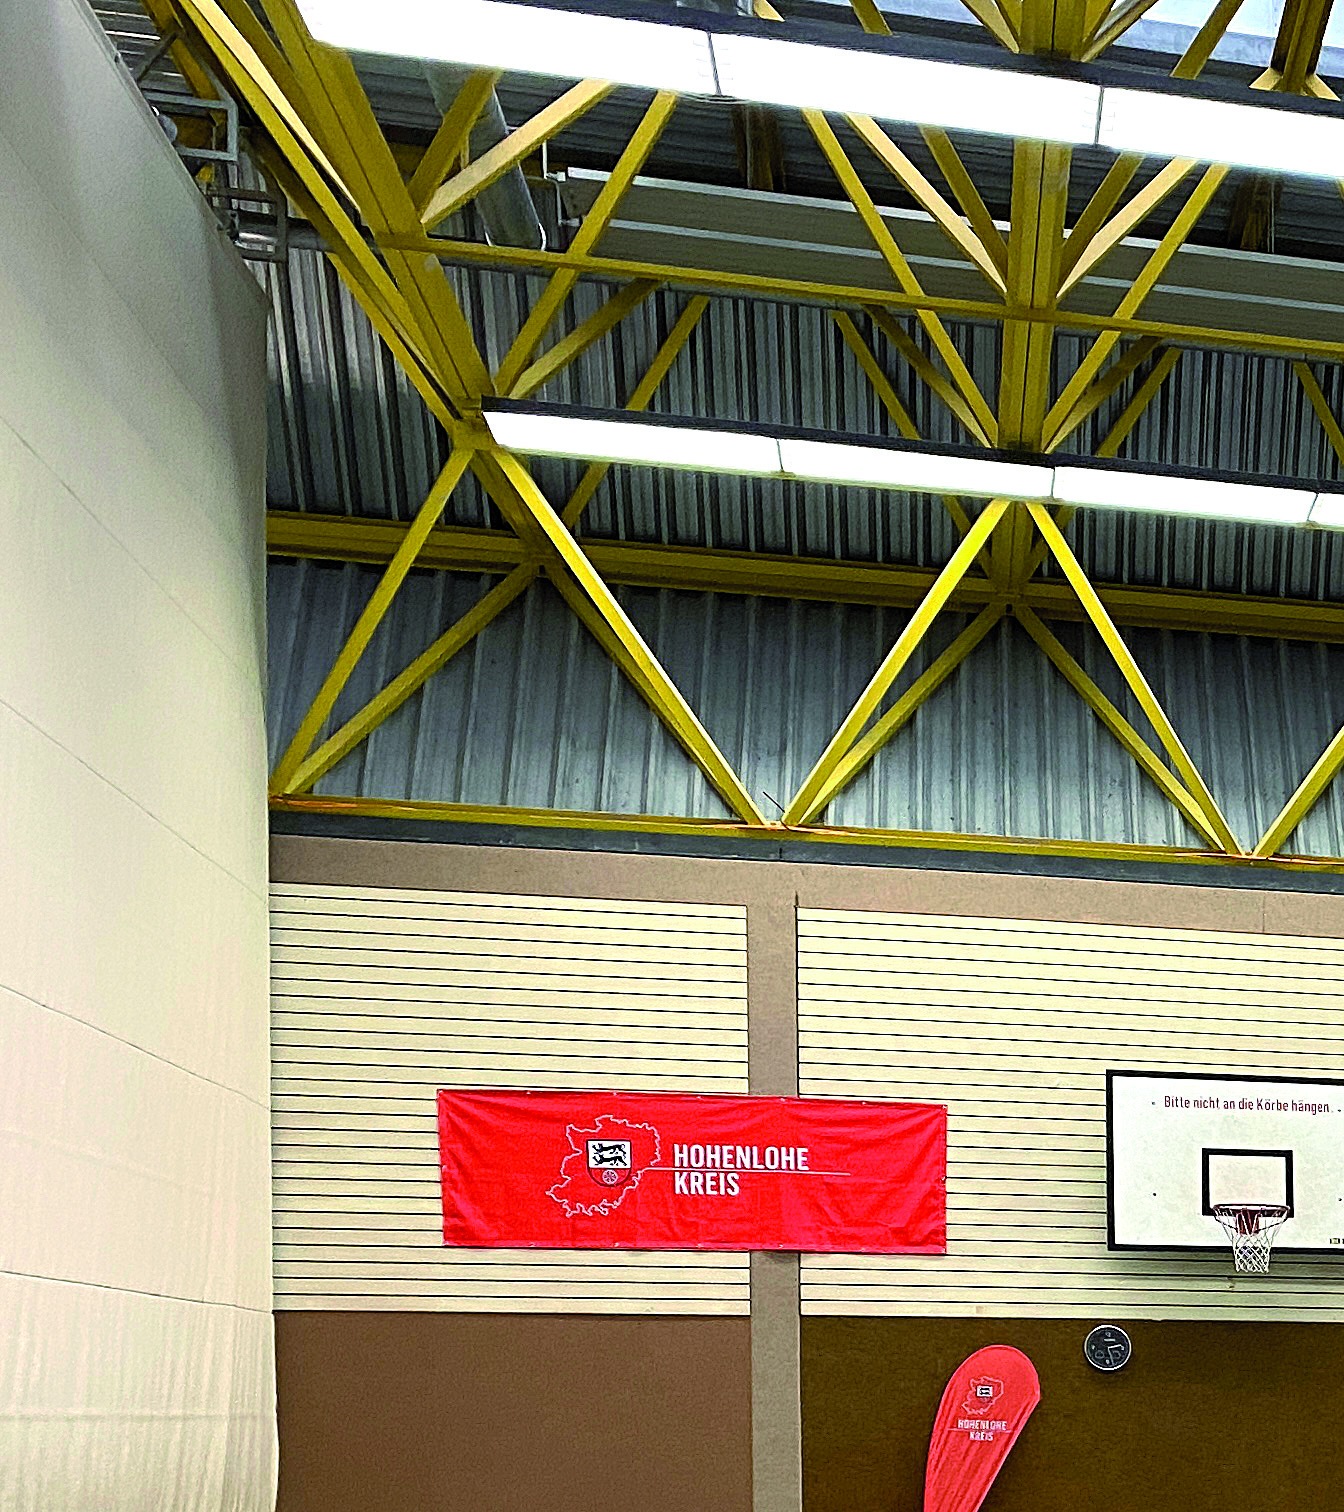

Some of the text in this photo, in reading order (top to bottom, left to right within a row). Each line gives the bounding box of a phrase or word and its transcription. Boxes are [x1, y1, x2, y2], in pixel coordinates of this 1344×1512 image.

[1164, 1095, 1191, 1109] Bitte
[1193, 1096, 1220, 1110] nicht
[1223, 1099, 1236, 1110] an
[1238, 1097, 1254, 1111] die
[1256, 1097, 1289, 1112] Körbe
[673, 1143, 810, 1171] HOHENLOHE
[674, 1171, 740, 1196] KREIS
